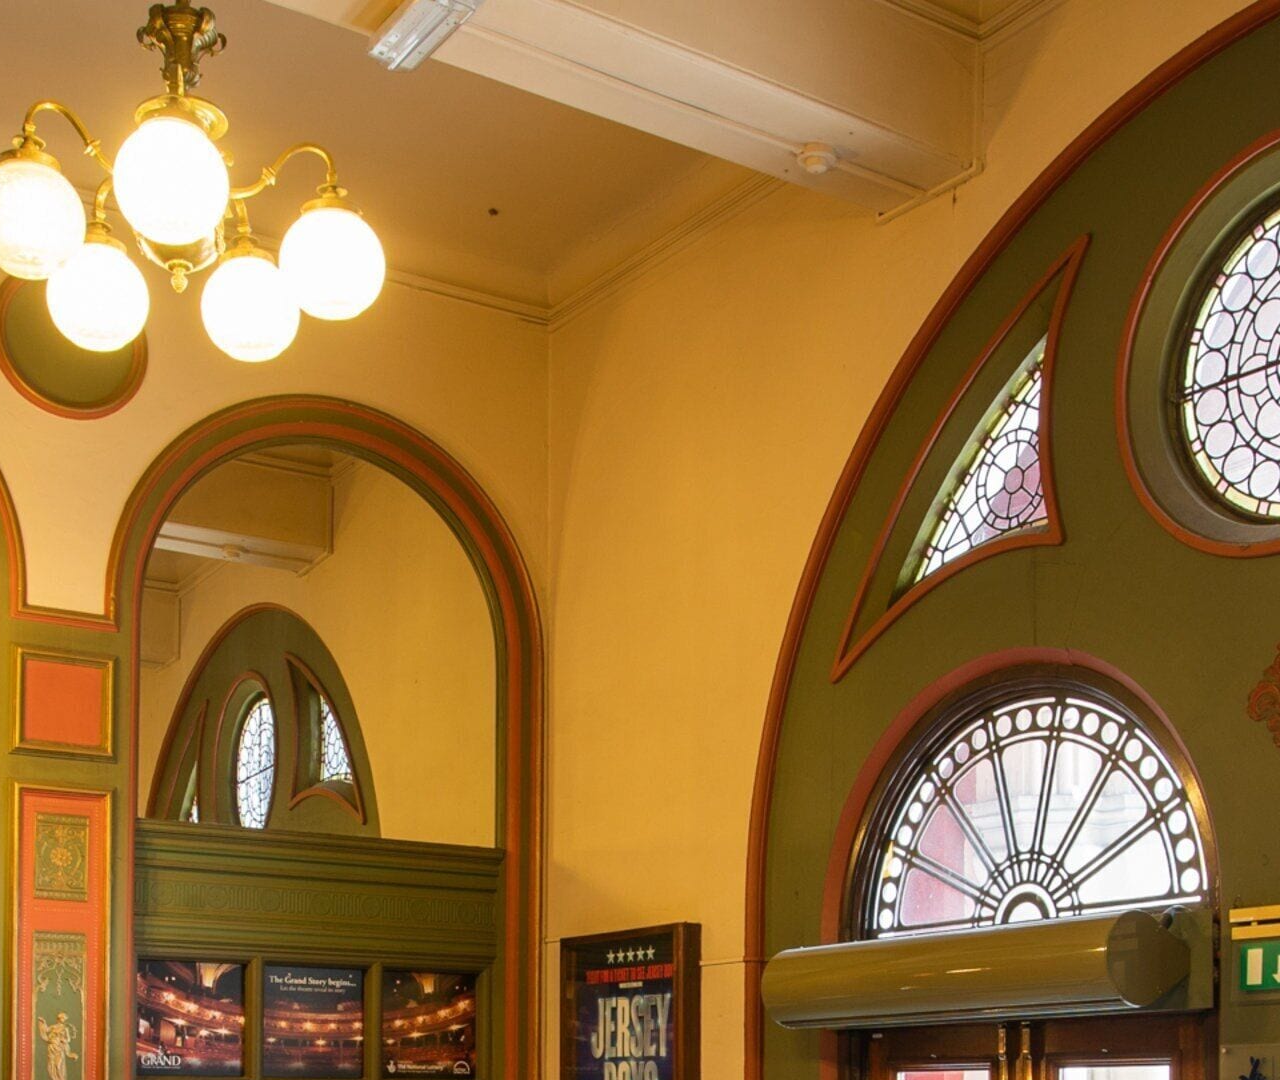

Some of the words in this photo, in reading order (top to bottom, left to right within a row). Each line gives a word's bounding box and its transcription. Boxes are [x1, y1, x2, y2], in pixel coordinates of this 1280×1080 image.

[285, 976, 307, 985] Grand
[308, 977, 326, 987] Story
[591, 993, 670, 1059] JERSEY
[141, 1055, 181, 1066] GRAND
